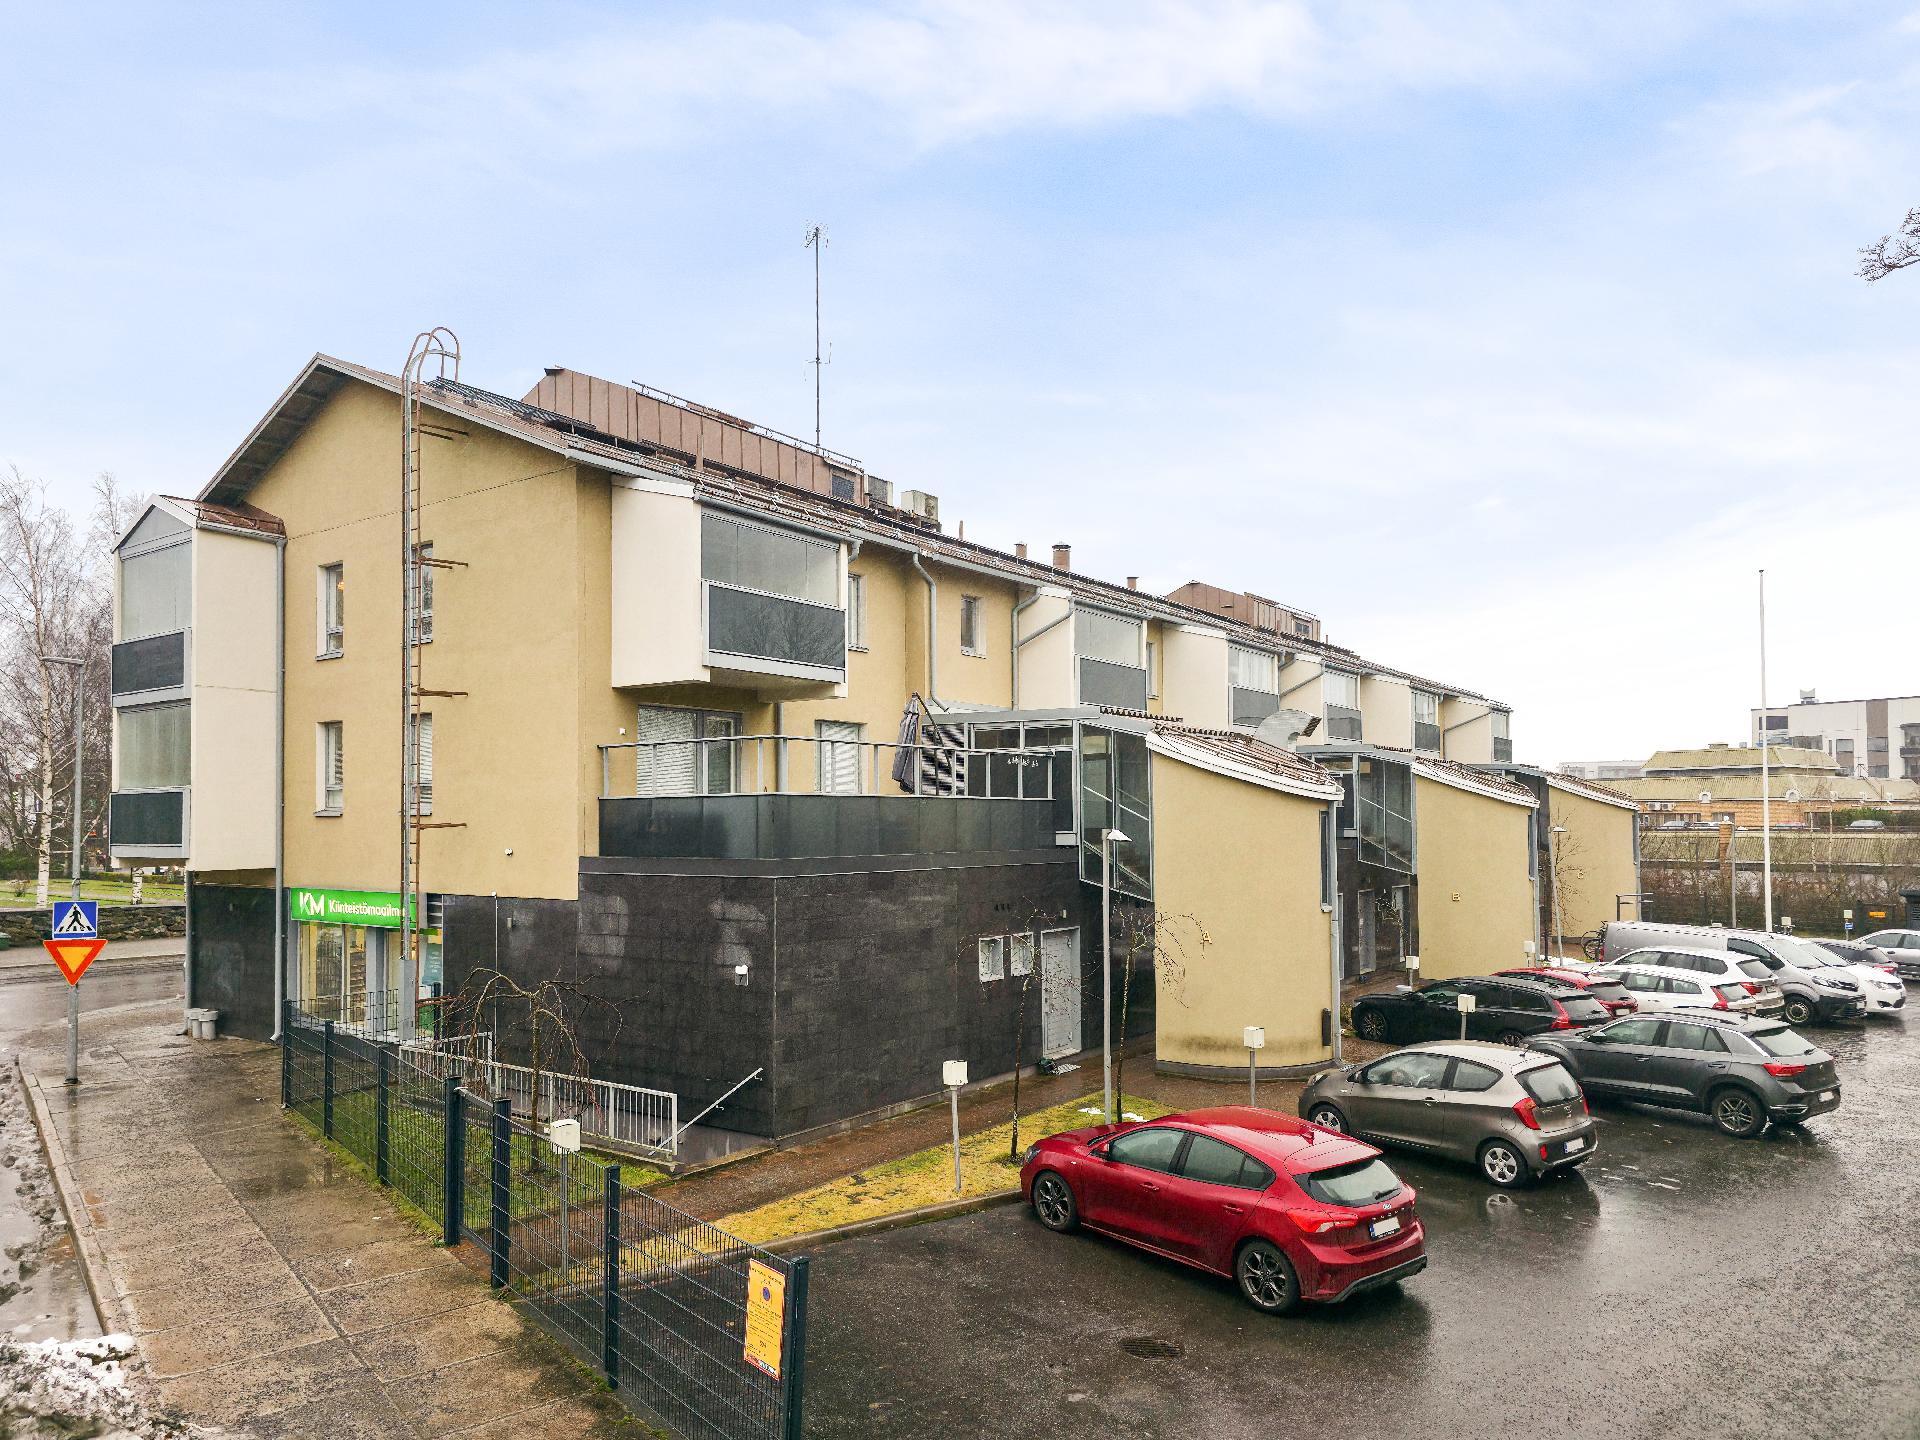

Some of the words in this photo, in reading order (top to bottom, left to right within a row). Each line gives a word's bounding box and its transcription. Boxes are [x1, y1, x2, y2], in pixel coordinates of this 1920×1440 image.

[299, 892, 325, 916] KM
[1452, 892, 1461, 902] B
[1201, 931, 1213, 945] A
